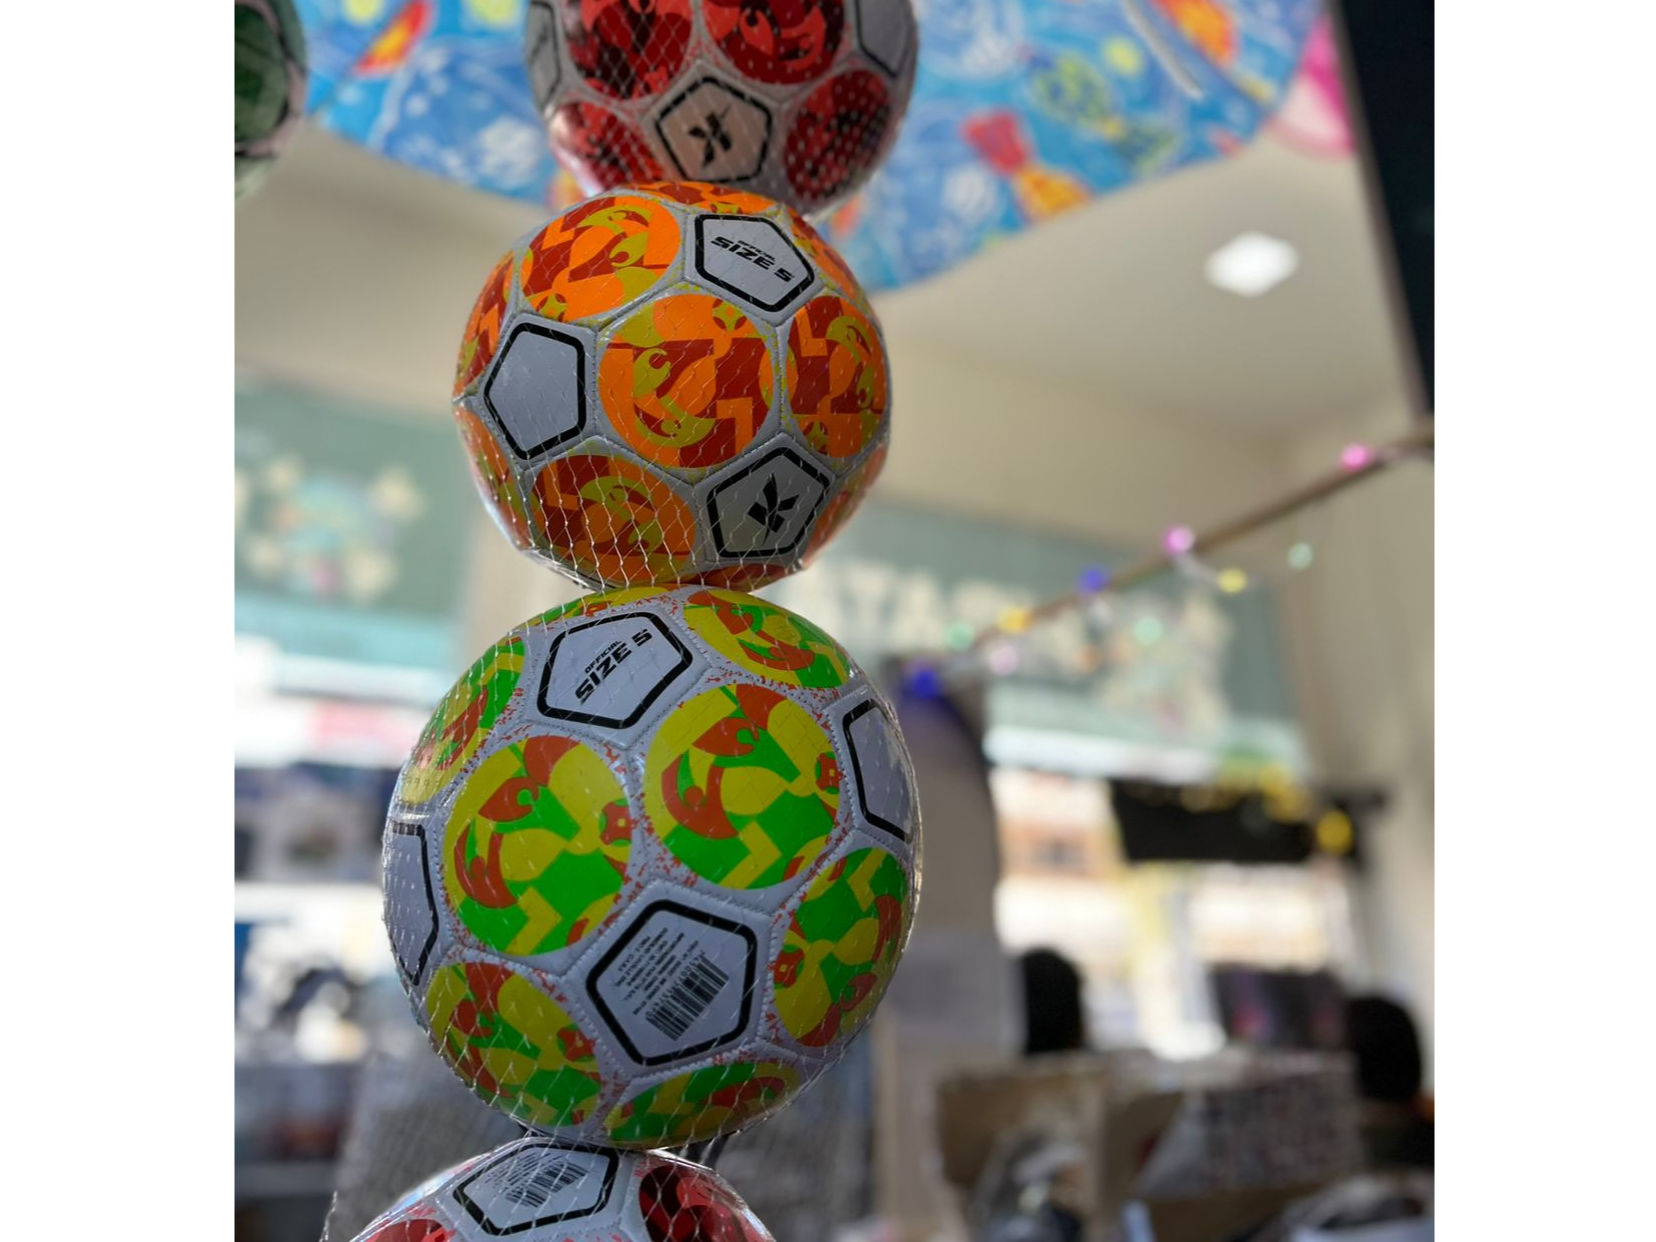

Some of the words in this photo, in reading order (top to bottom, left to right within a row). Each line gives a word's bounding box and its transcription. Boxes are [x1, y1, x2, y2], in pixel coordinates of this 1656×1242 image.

[711, 236, 775, 271] SIZE
[774, 267, 795, 283] 5
[575, 642, 632, 705] SIZE
[632, 628, 653, 647] 5
[584, 640, 622, 674] OFFICIAL
